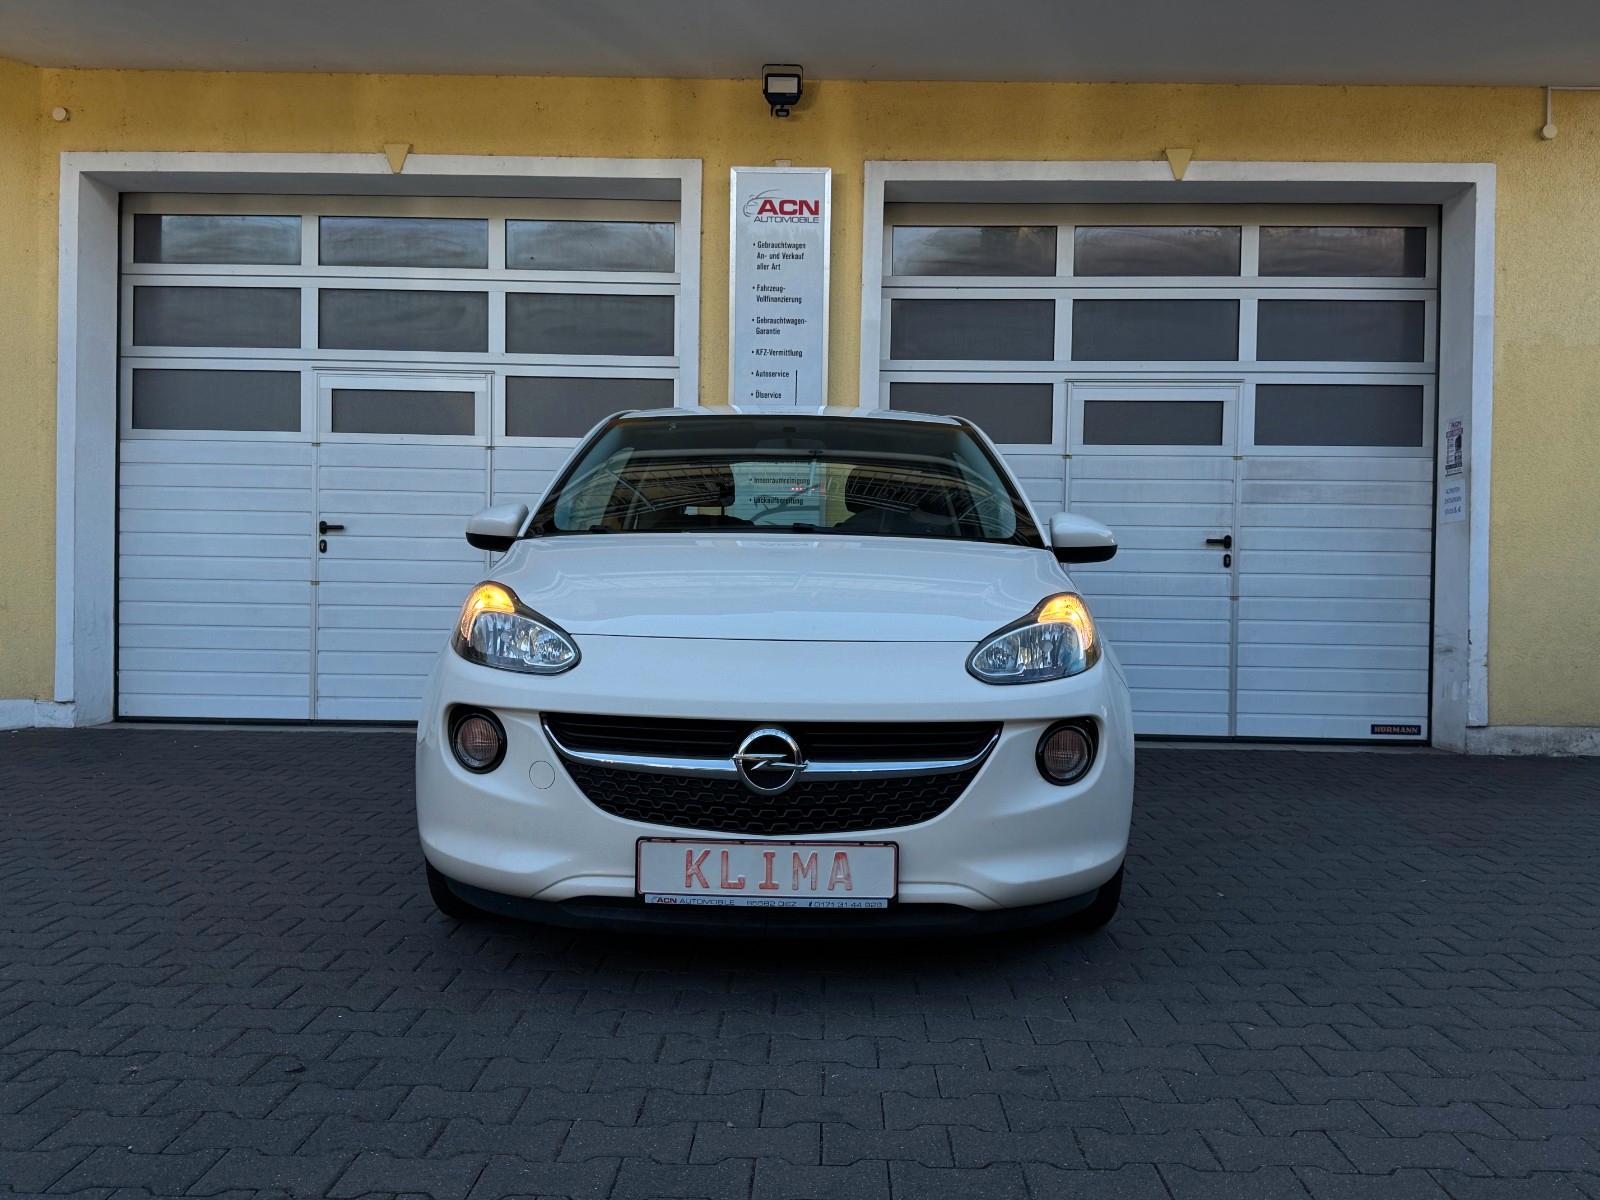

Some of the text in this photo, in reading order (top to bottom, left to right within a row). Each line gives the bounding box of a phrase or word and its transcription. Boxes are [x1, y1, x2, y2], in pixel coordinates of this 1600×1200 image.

[757, 199, 820, 216] ACN
[753, 216, 820, 224] AUTOMOBILE
[757, 241, 807, 251] Gebrauchtwagen
[782, 252, 805, 260] Verkauf
[756, 263, 781, 271] aller Art
[756, 284, 786, 293] Fahrzeug-
[756, 295, 803, 304] Vollfinanzierung
[756, 317, 807, 326] Gebrauchtwagen-
[756, 327, 781, 335] Garantie
[755, 348, 803, 358] KFZ-Vermittlung
[755, 369, 790, 378] Autoservice
[755, 389, 782, 399] Ölservice
[685, 848, 854, 892] KLIMA
[679, 898, 736, 906] AUTOMOBILE
